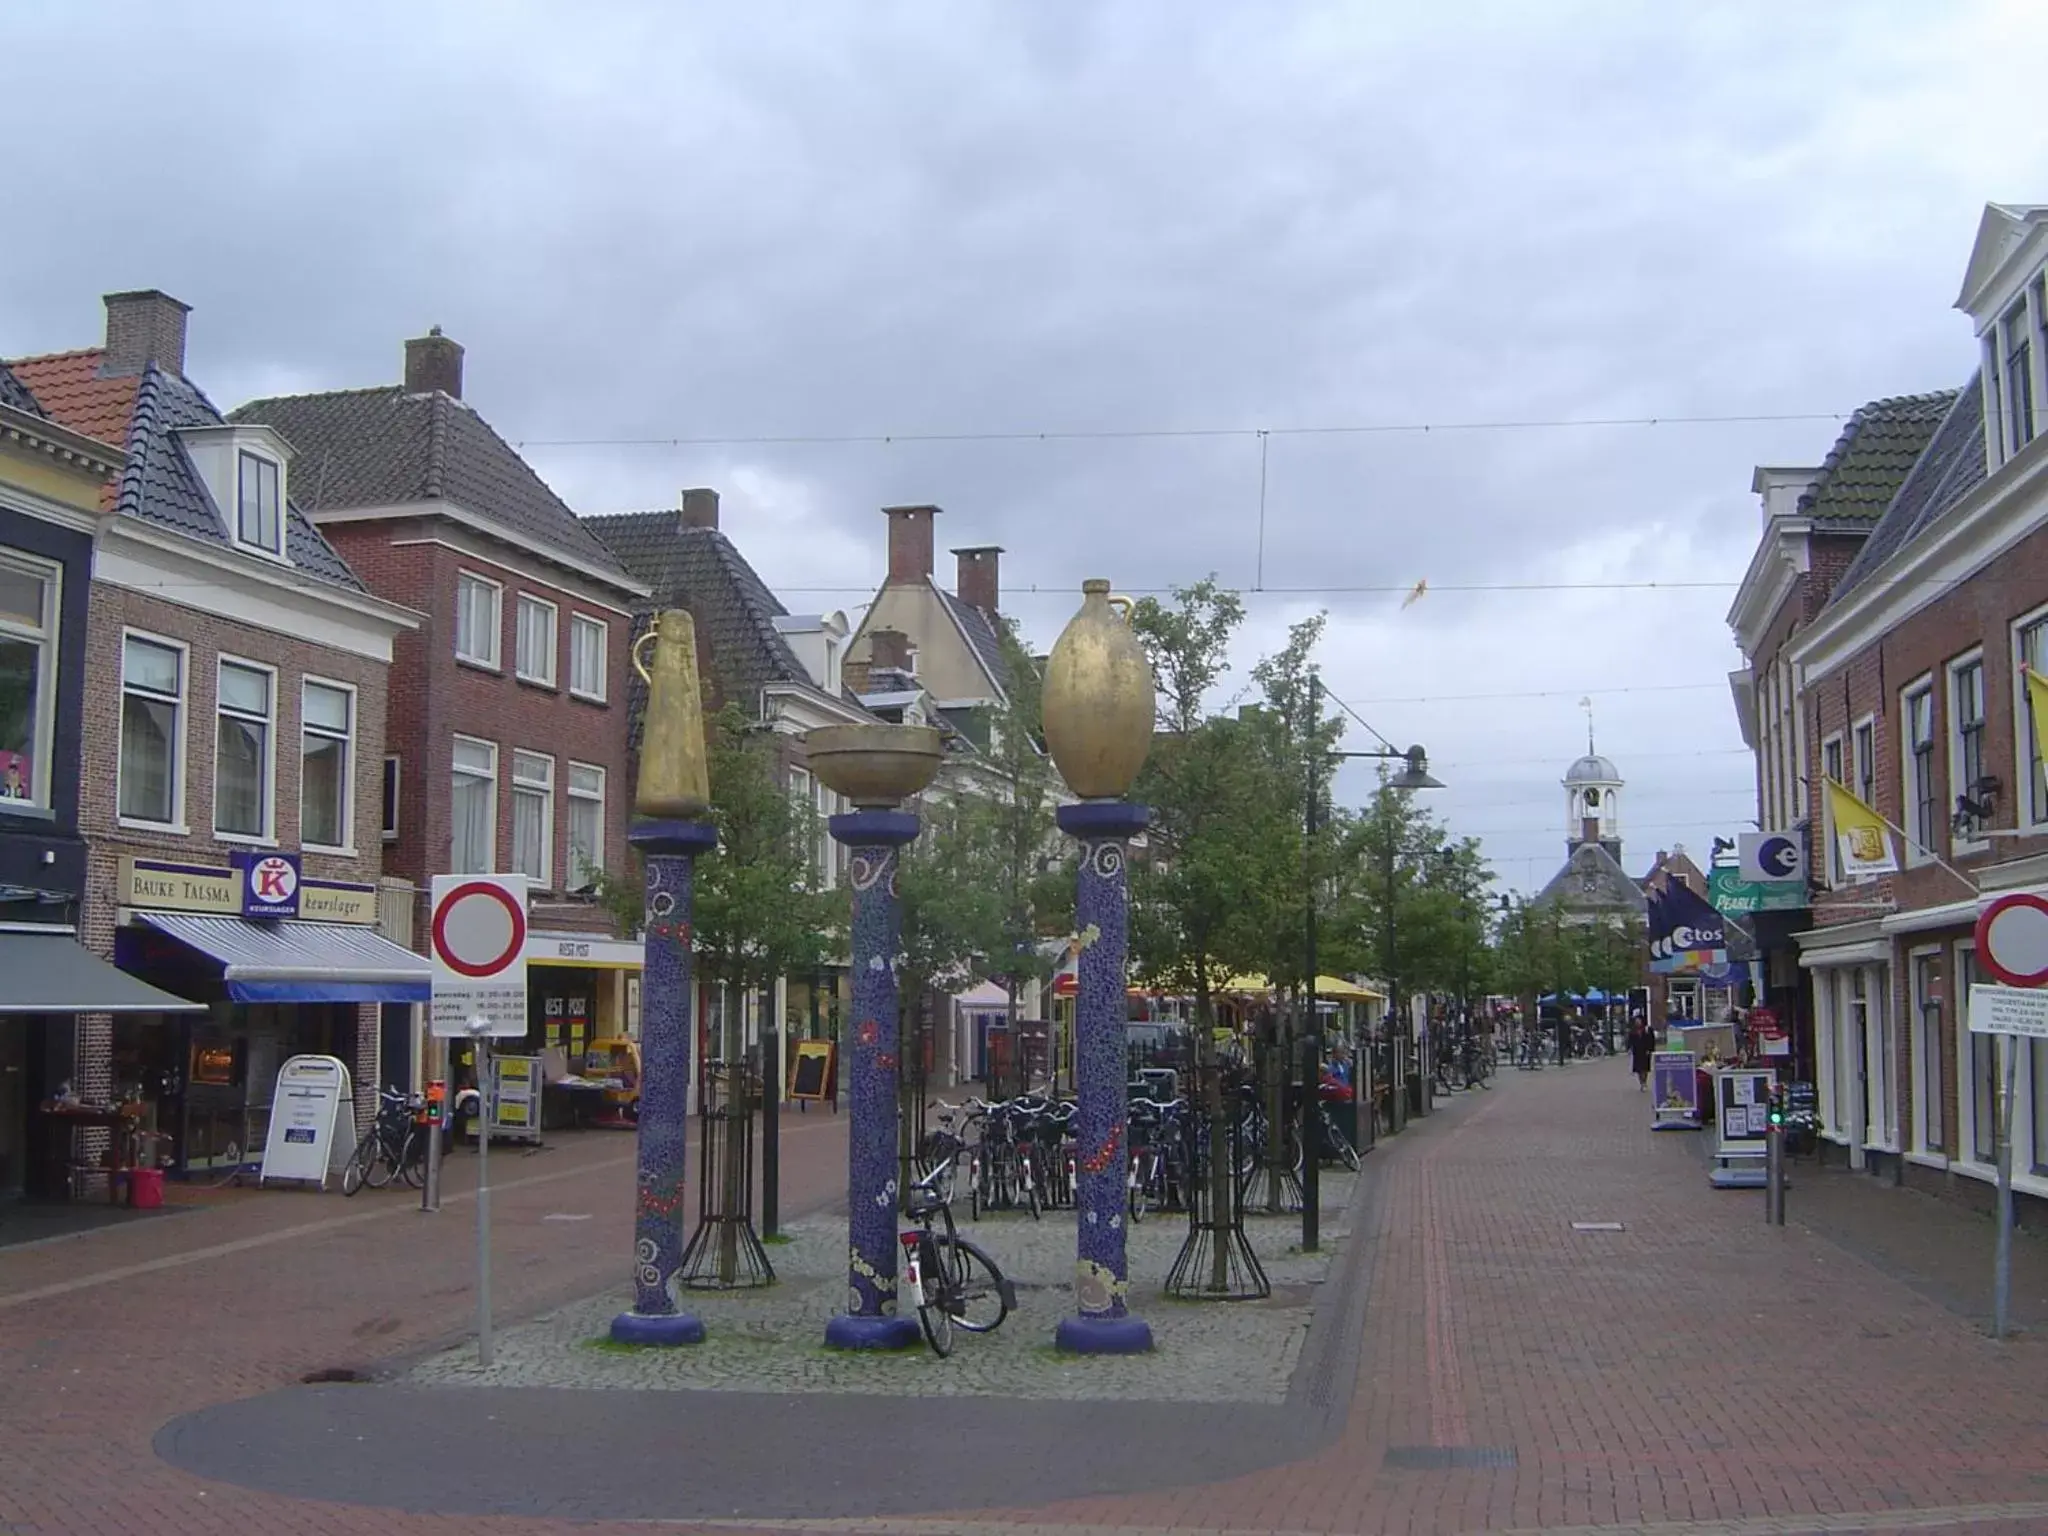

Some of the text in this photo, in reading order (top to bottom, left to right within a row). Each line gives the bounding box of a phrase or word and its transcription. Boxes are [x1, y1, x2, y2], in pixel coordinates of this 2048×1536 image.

[134, 876, 229, 902] BAUKE TALSMA
[259, 870, 288, 897] K
[304, 893, 360, 917] keurslager
